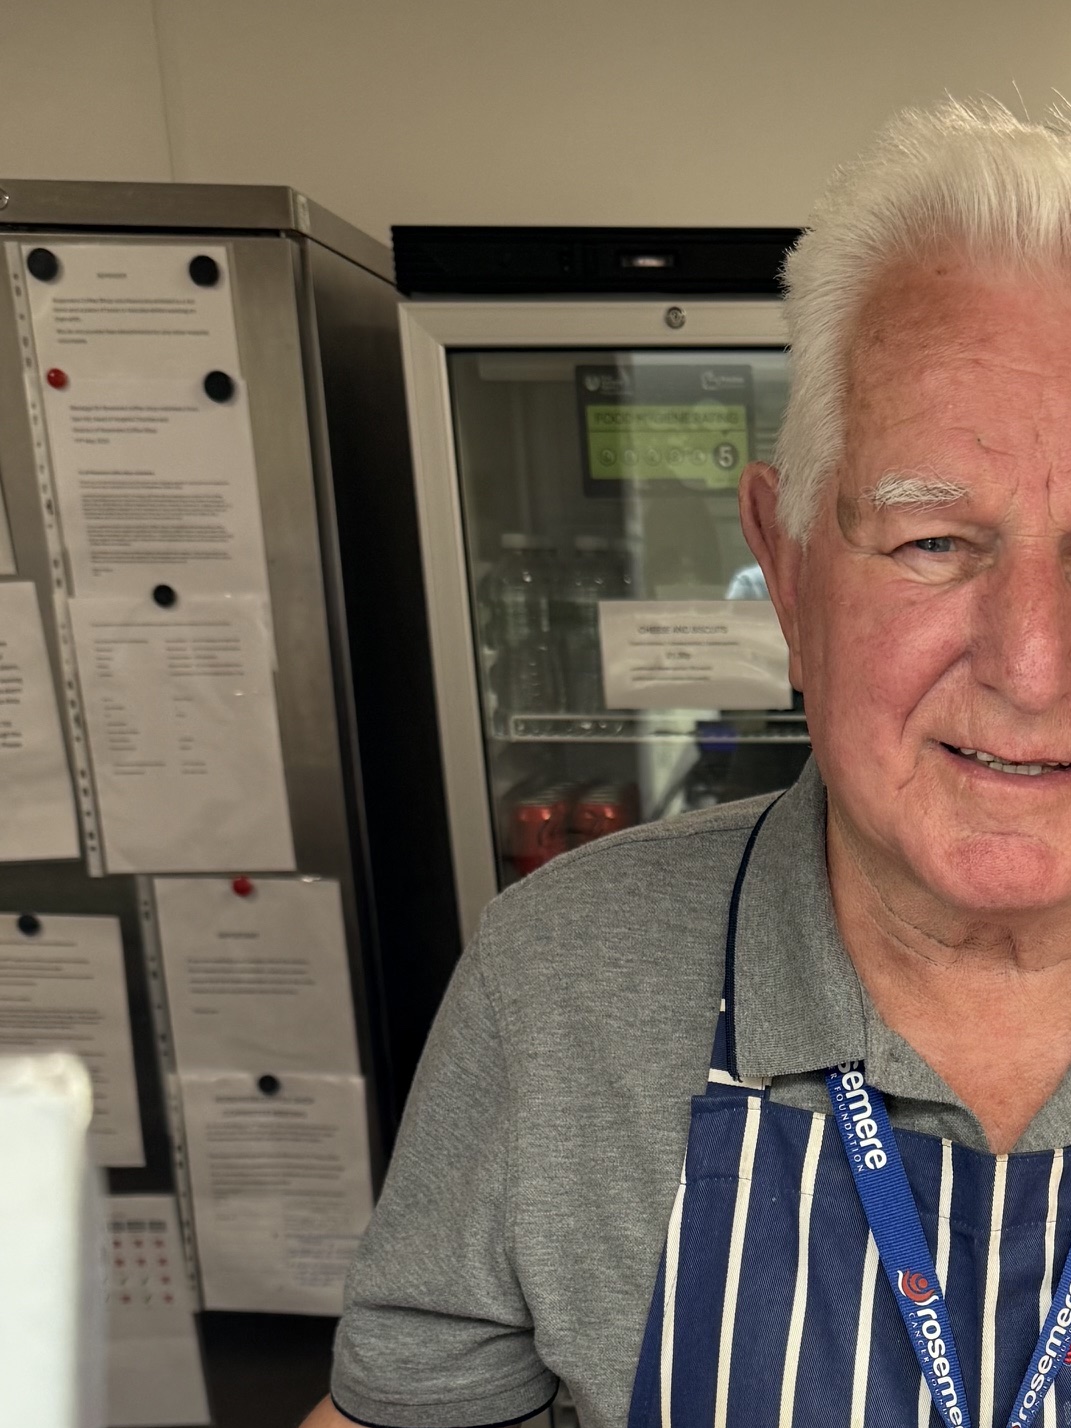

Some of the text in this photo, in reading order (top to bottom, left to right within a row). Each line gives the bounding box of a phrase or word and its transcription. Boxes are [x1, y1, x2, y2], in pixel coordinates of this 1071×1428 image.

[717, 446, 734, 469] 5
[834, 1085, 865, 1173] FOUNDATION
[837, 1060, 888, 1171] semere
